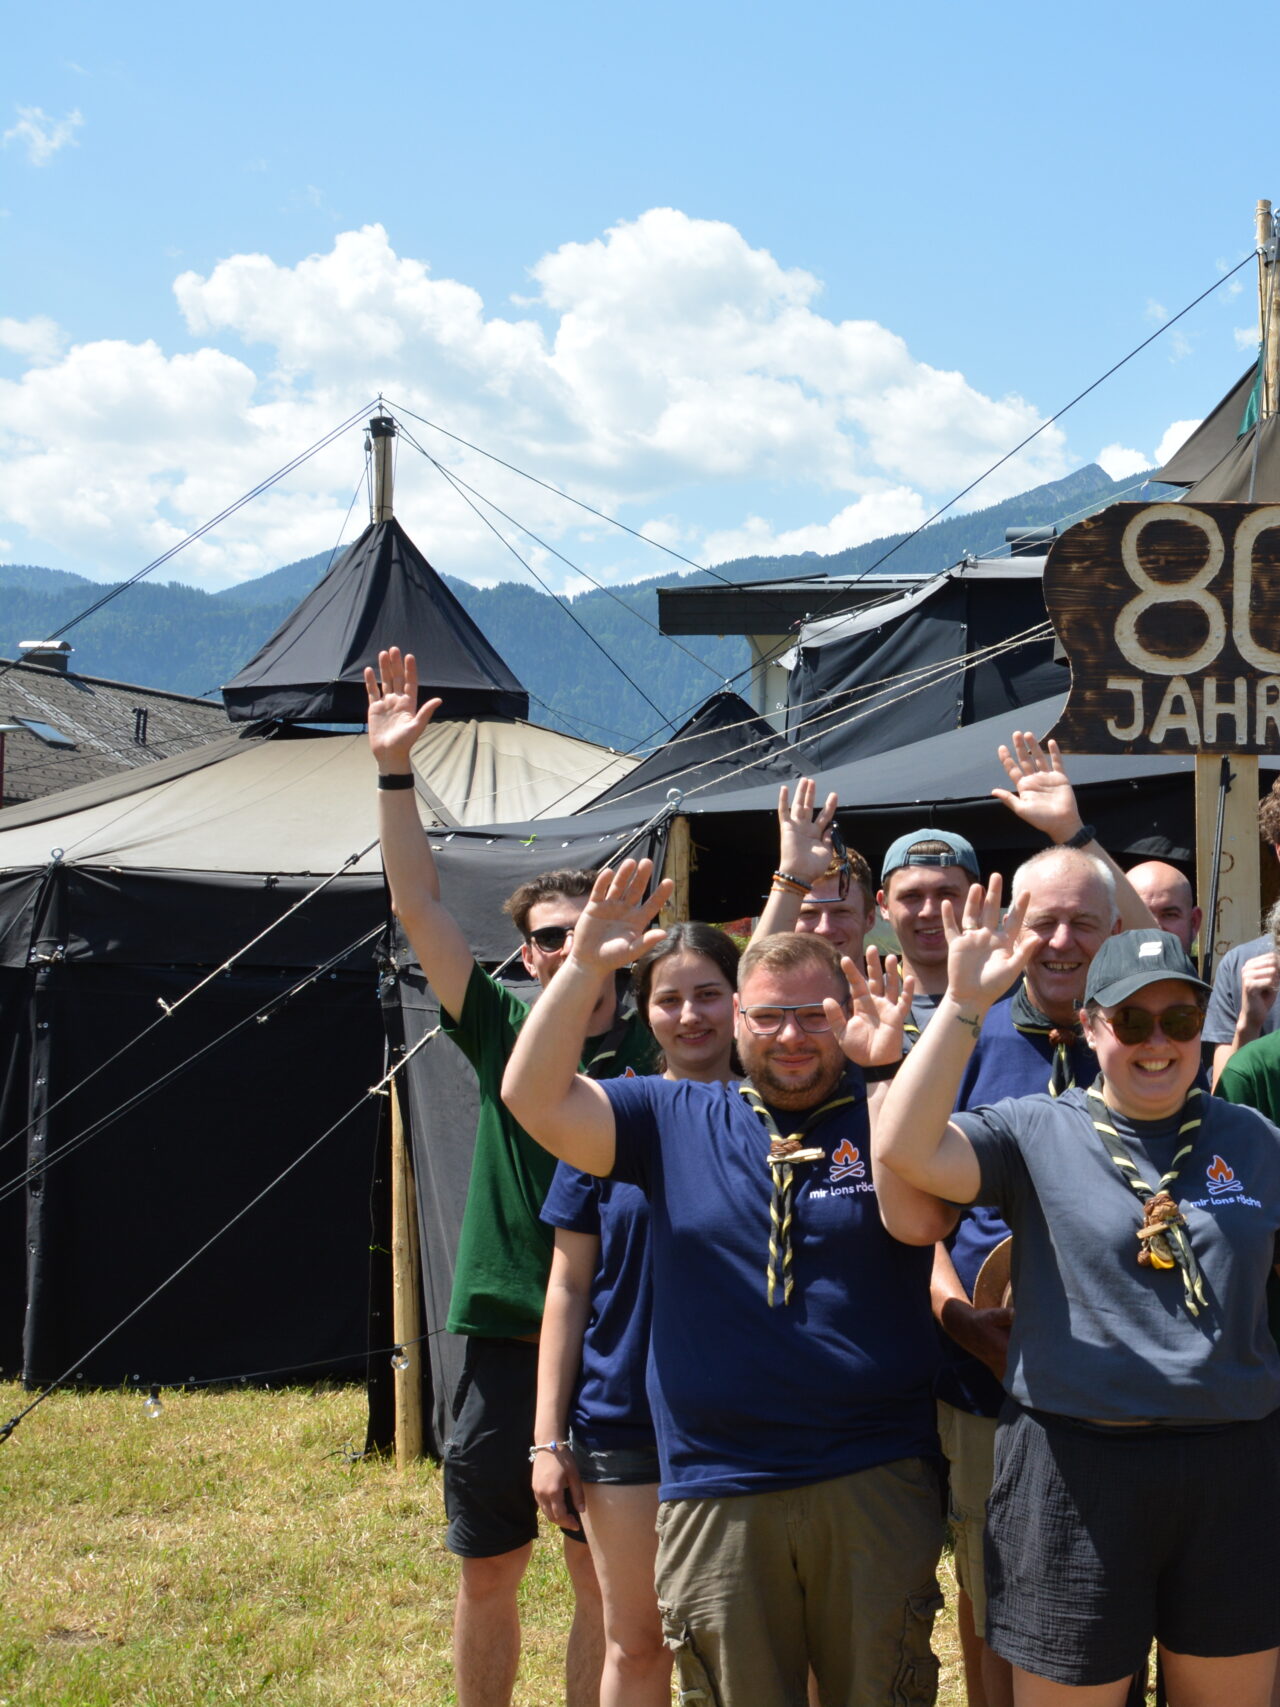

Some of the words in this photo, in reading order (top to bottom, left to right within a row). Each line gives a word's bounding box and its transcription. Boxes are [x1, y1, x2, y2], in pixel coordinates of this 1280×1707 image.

[809, 1188, 829, 1199] mir
[830, 1185, 855, 1197] lons
[856, 1181, 876, 1193] röc
[1190, 1198, 1210, 1208] mir
[1210, 1196, 1236, 1206] lons
